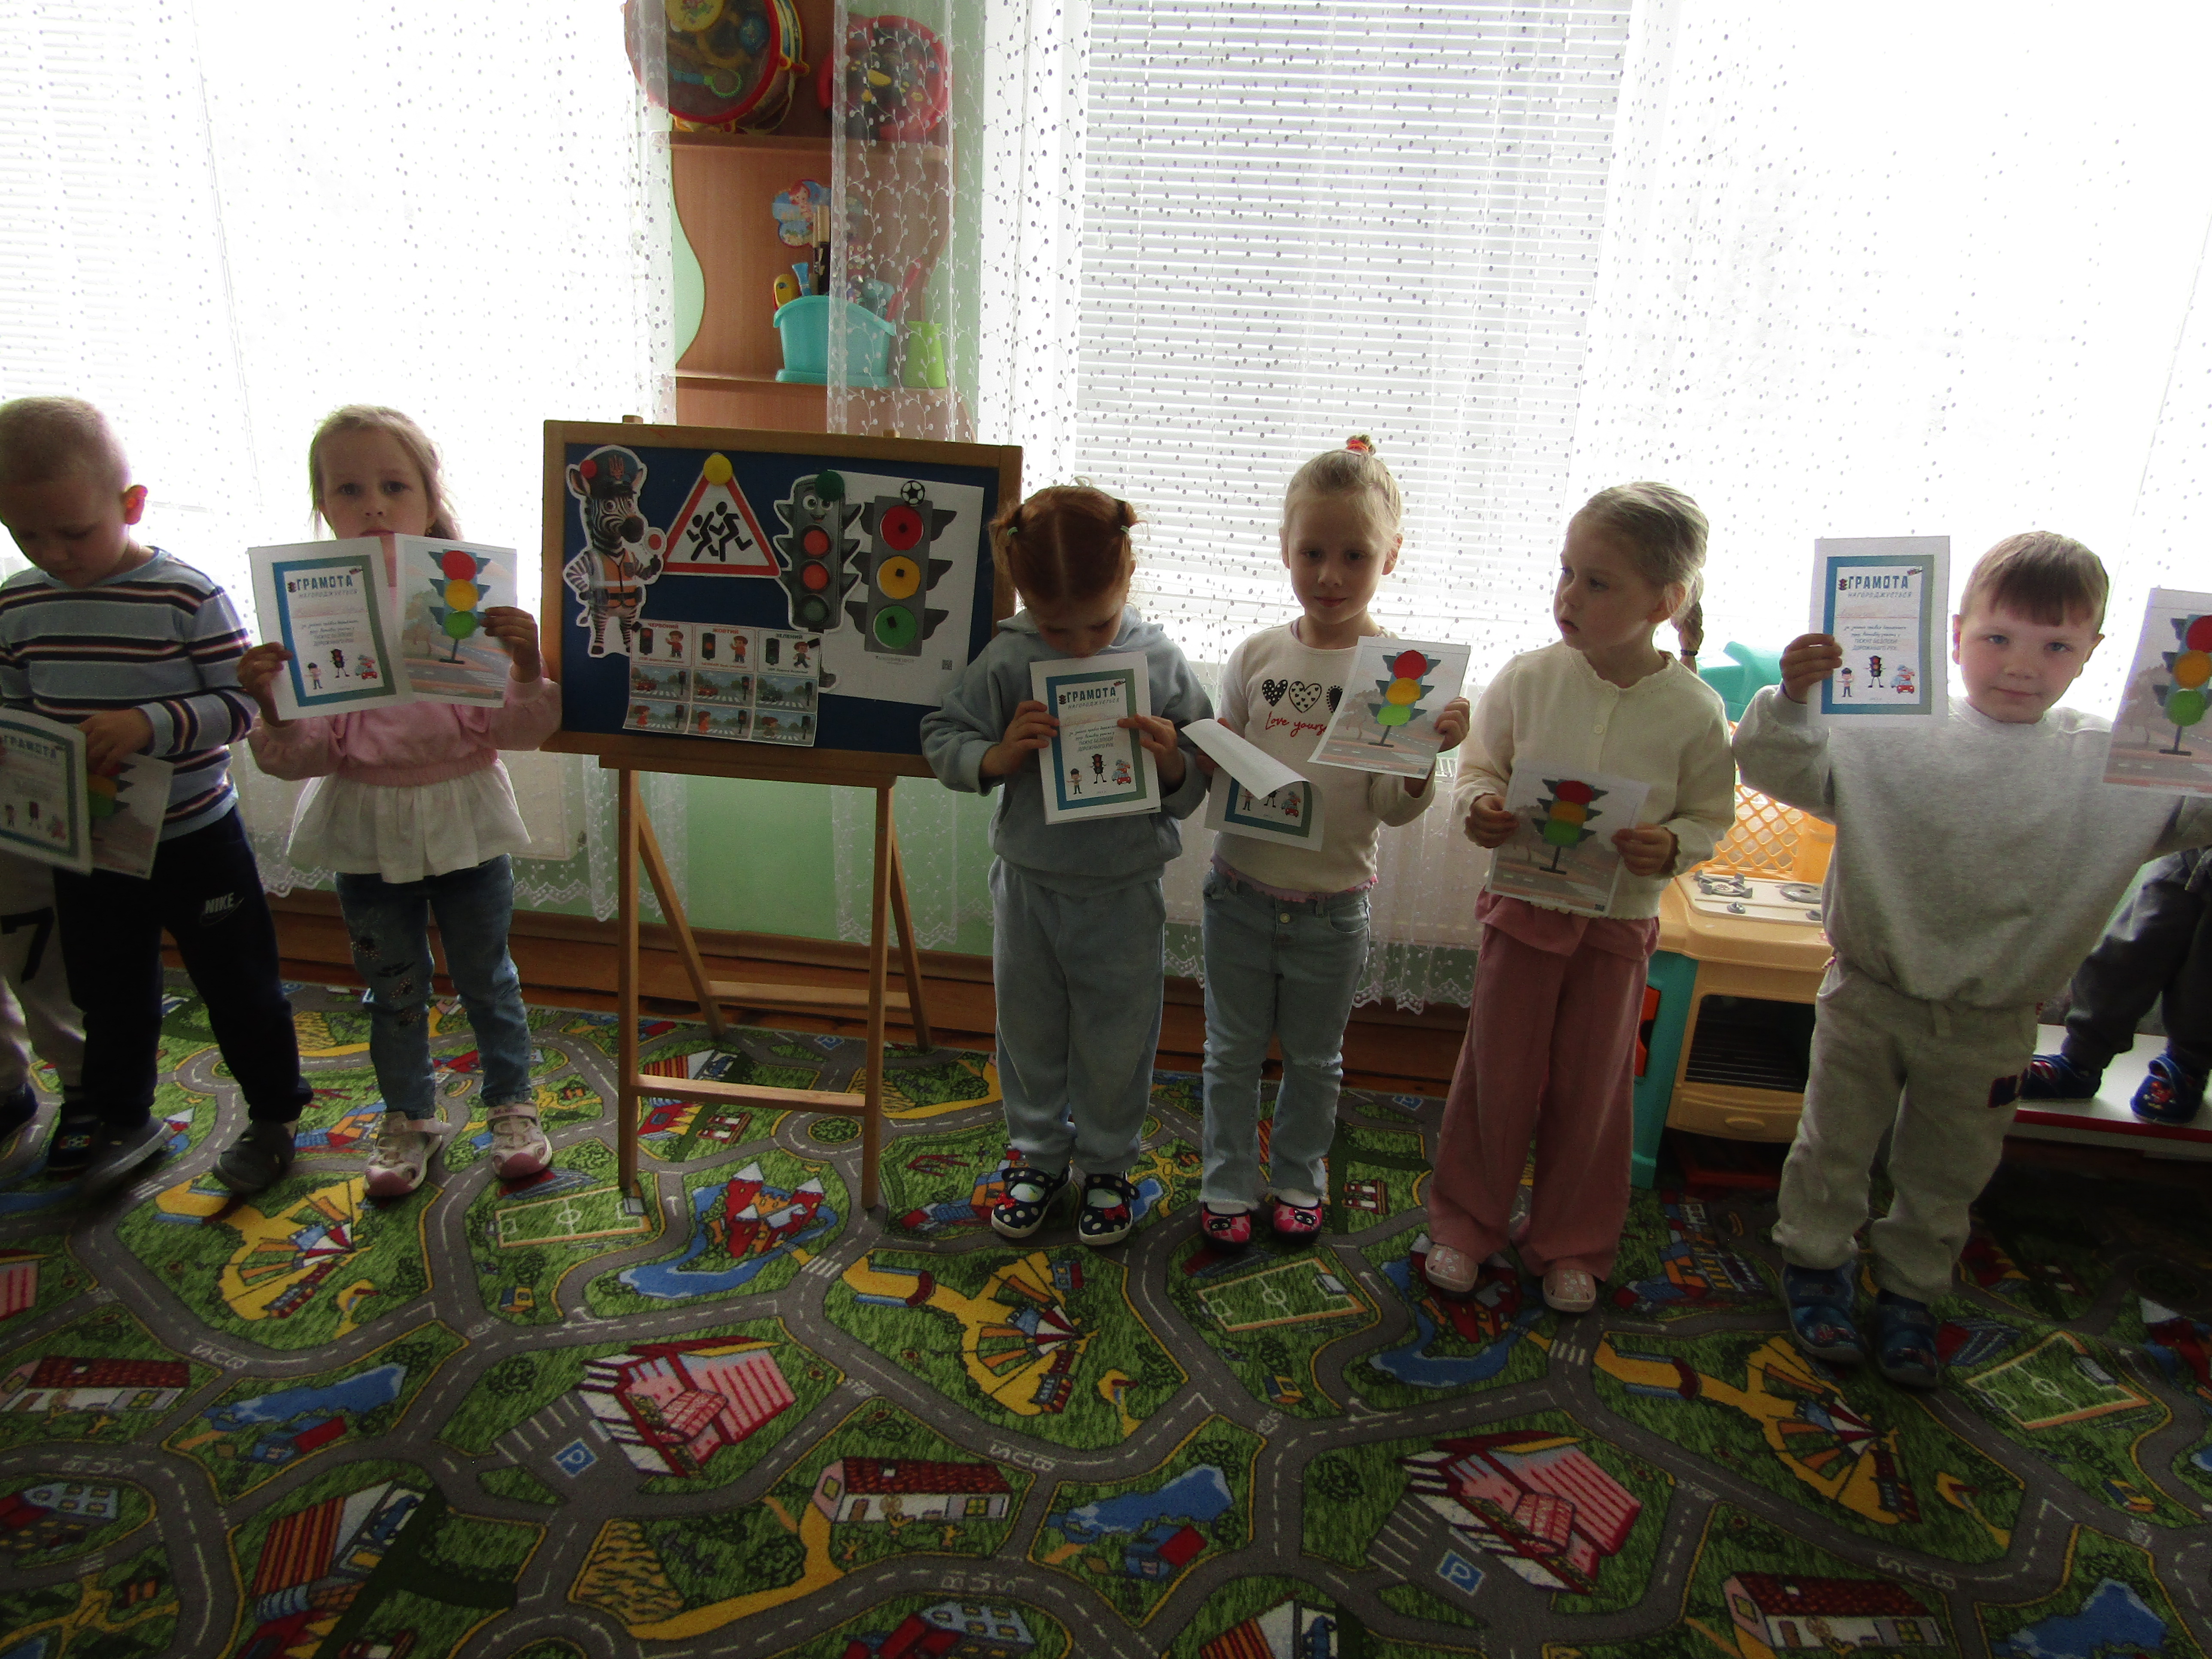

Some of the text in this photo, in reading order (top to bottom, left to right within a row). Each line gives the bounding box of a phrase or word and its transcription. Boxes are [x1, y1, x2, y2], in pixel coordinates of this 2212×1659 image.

[297, 574, 353, 591] ГРАМОТА
[1848, 575, 1908, 589] ГРАМОТА
[647, 622, 679, 630] ЧЕРВОНИЙ
[1066, 687, 1116, 703] ГРАМОТА
[1265, 711, 1327, 737] Love yours
[205, 892, 234, 914] NIKE
[1, 907, 54, 984] 7
[559, 1449, 585, 1465] P
[1447, 1562, 1471, 1581] P
